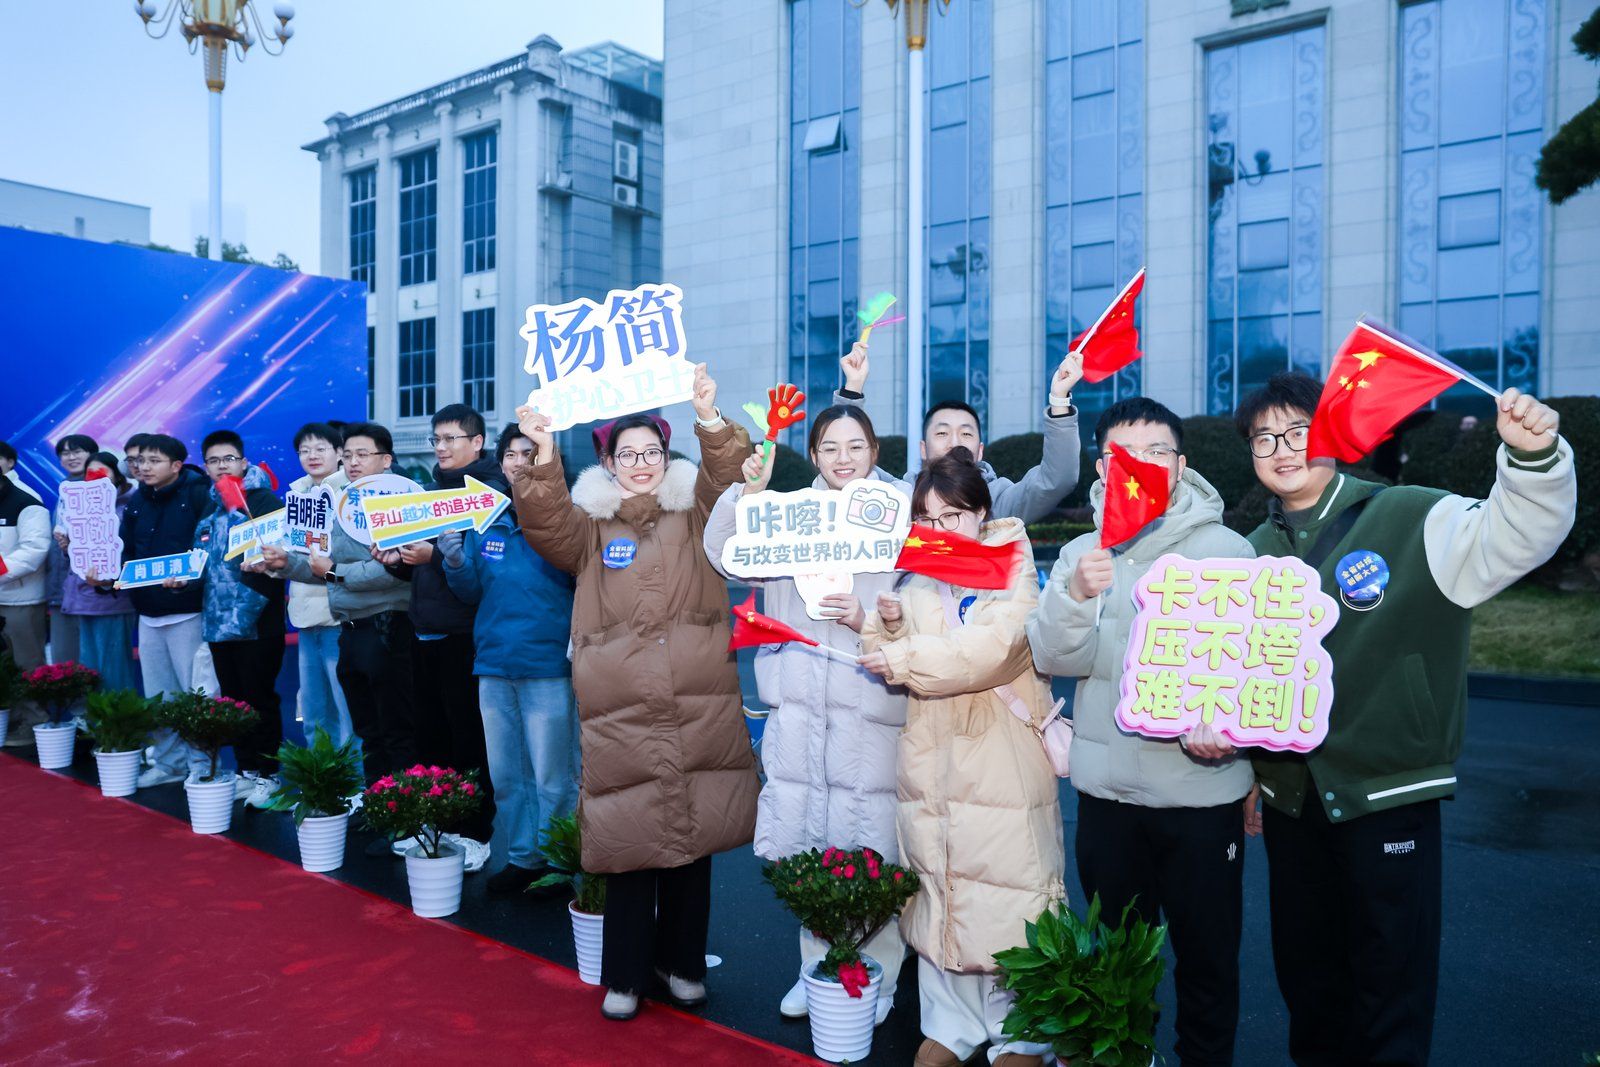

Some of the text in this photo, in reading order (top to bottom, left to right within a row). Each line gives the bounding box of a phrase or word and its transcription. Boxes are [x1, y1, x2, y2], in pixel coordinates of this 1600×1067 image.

[527, 289, 681, 383] 杨简
[551, 362, 692, 423] 护心卫士
[287, 495, 327, 530] 肖明清
[369, 492, 495, 528] 穿山越水的追光者
[746, 498, 838, 538] 咔嚓!
[231, 518, 286, 547] 肖明清院
[134, 558, 183, 580] 肖明清
[1130, 668, 1321, 734] 难不倒!
